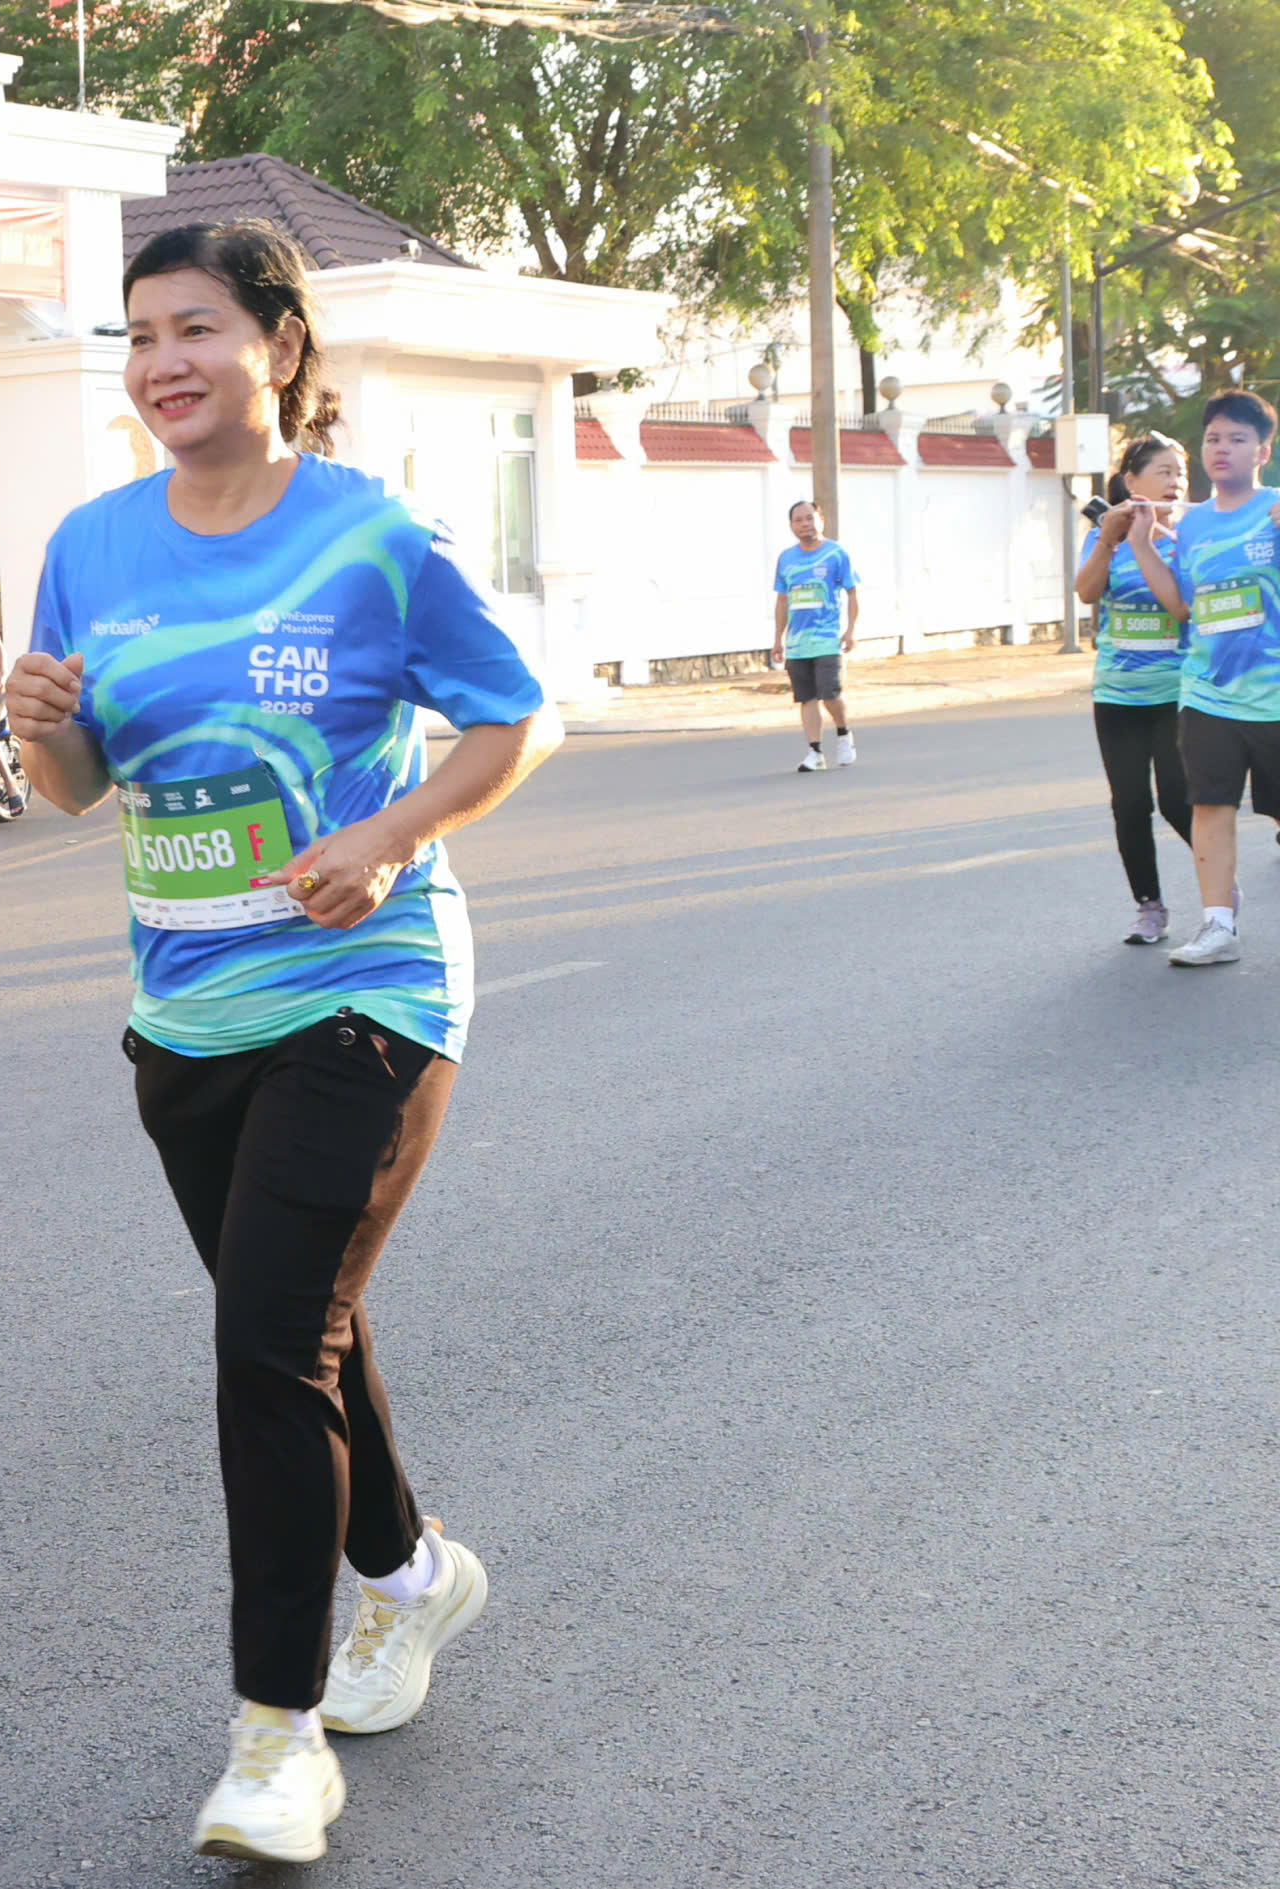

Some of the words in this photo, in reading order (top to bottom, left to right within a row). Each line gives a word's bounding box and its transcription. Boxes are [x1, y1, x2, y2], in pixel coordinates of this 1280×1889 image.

[281, 623, 335, 635] Marathon
[248, 644, 329, 671] CAN
[248, 669, 330, 697] THO
[259, 701, 315, 716] 2026
[142, 828, 236, 873] 50058
[247, 822, 265, 863] F
